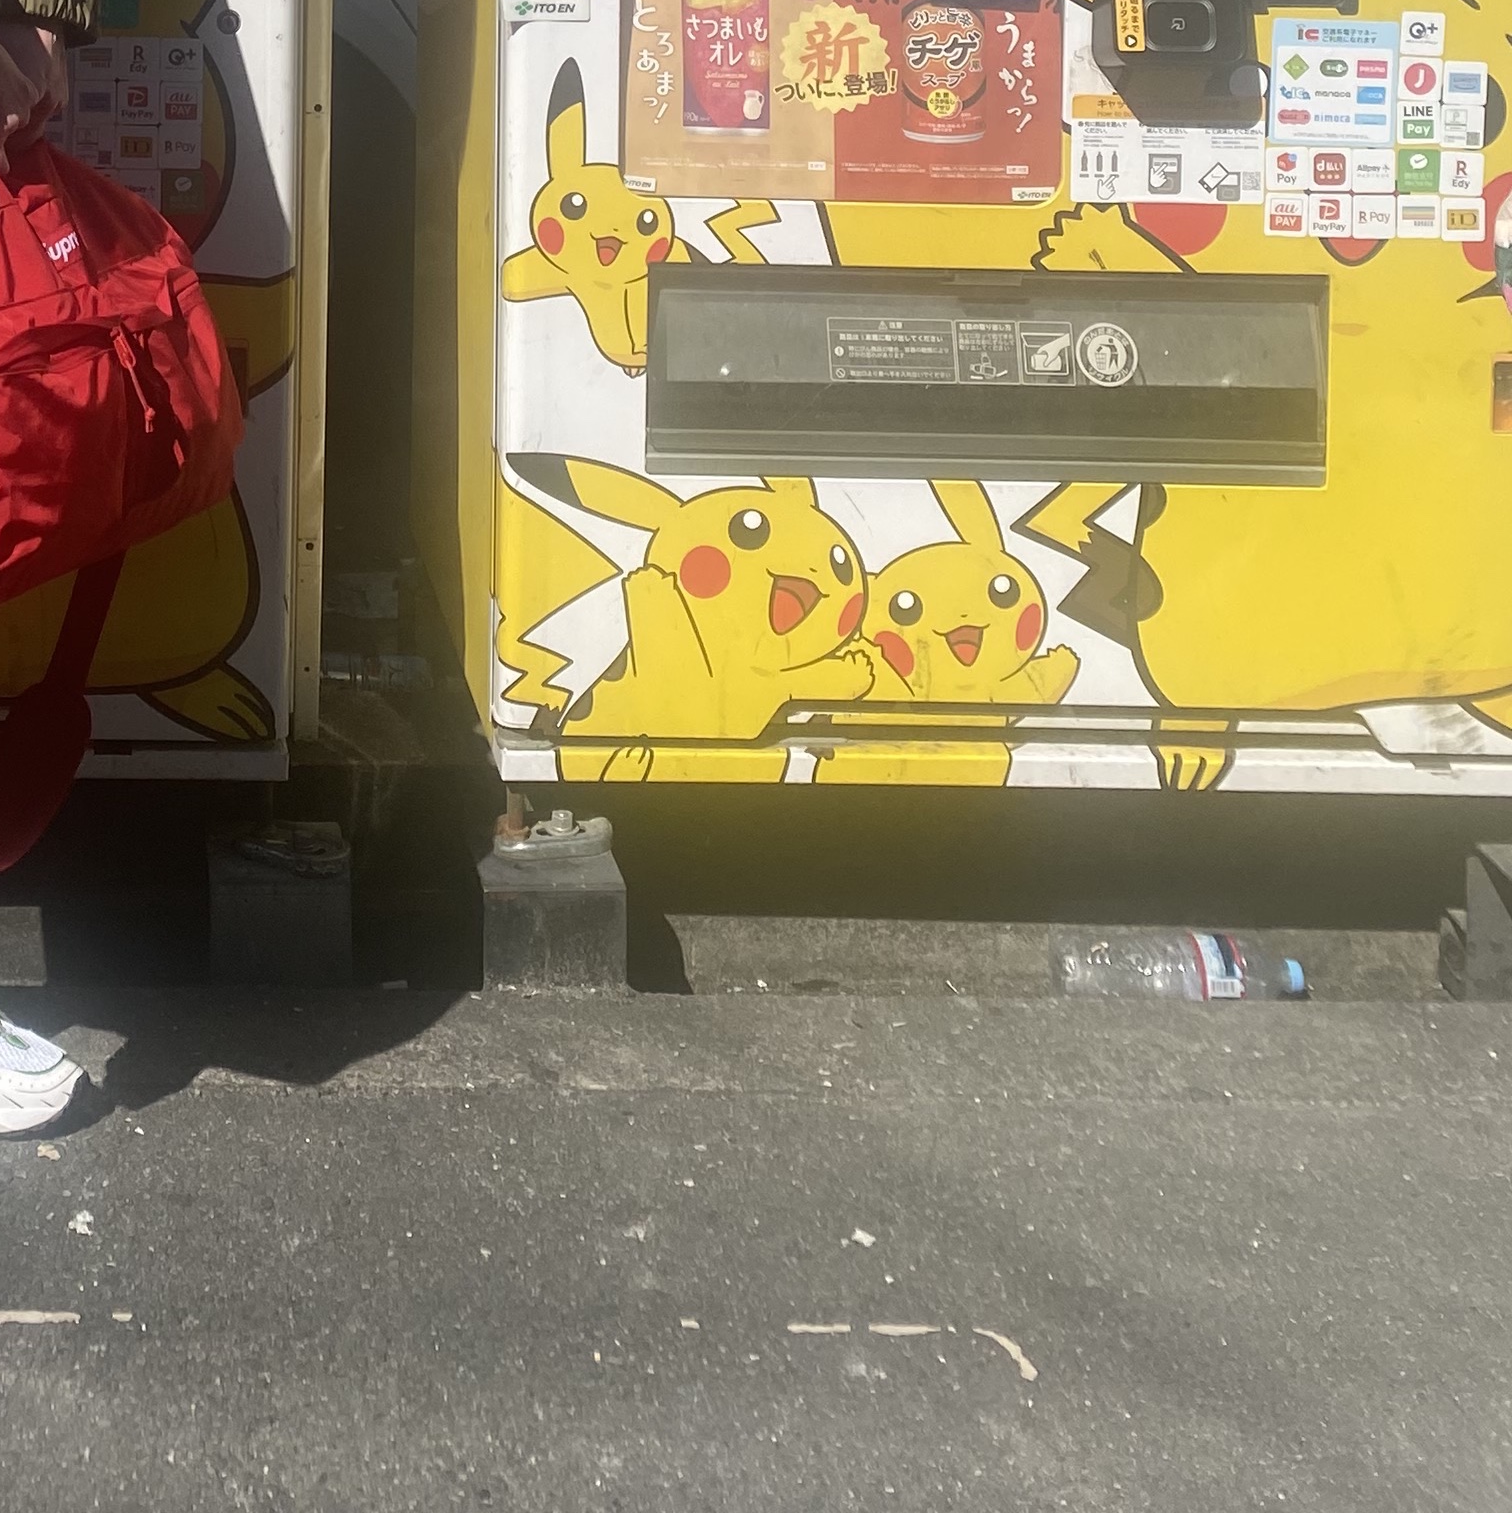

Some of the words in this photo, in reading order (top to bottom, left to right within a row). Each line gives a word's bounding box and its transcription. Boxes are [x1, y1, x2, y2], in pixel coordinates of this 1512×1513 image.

[533, 3, 555, 13] ITO
[557, 3, 576, 14] EN
[685, 14, 768, 42] さつまいも
[708, 41, 743, 66] オレ
[800, 21, 871, 84] 新
[906, 31, 982, 68] チゲ
[775, 69, 899, 104] ついに、登場!
[922, 72, 966, 88] スープ
[1403, 105, 1433, 117] LINE
[1407, 123, 1431, 137] Pay
[1277, 173, 1297, 185] Pay
[1452, 178, 1470, 190] Edy
[1274, 202, 1299, 214] au
[1274, 215, 1297, 227] PAY
[1369, 210, 1391, 224] Pay
[1312, 222, 1347, 232] PayPay
